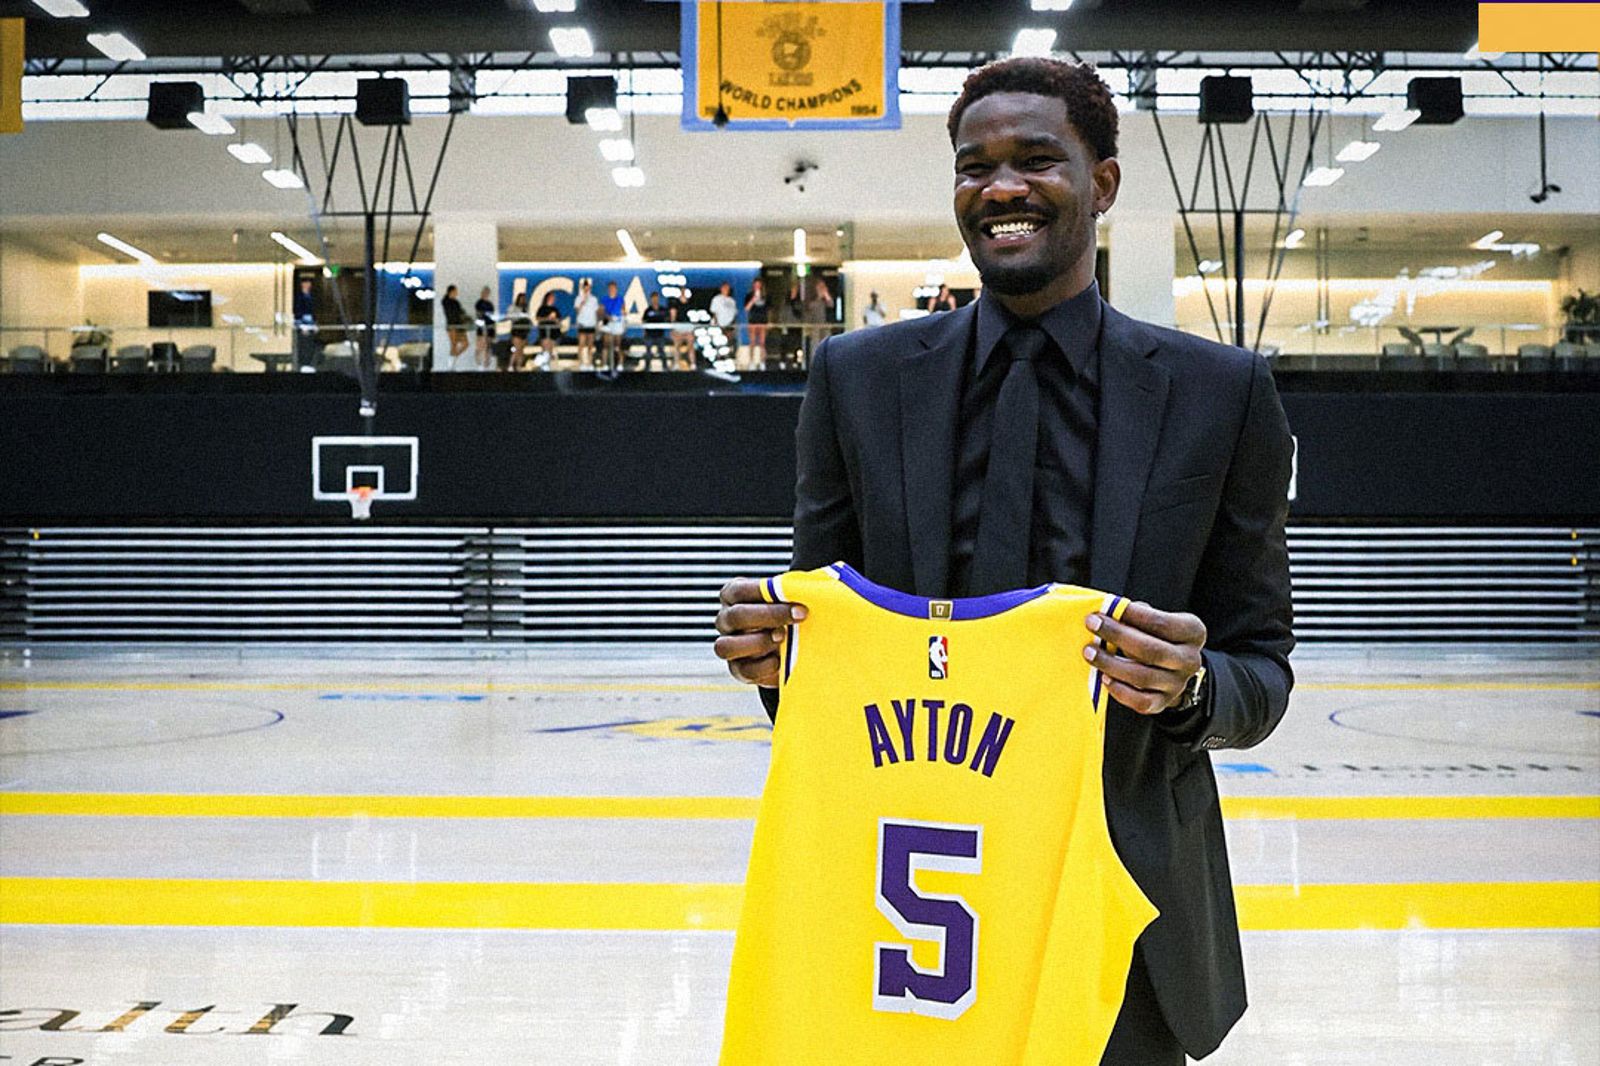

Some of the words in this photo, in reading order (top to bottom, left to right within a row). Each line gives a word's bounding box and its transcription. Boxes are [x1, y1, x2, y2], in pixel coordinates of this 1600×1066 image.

[720, 80, 772, 110] WORLD
[776, 78, 863, 112] CHAMPIONS
[864, 699, 1015, 778] AYTON
[872, 817, 984, 1021] 5
